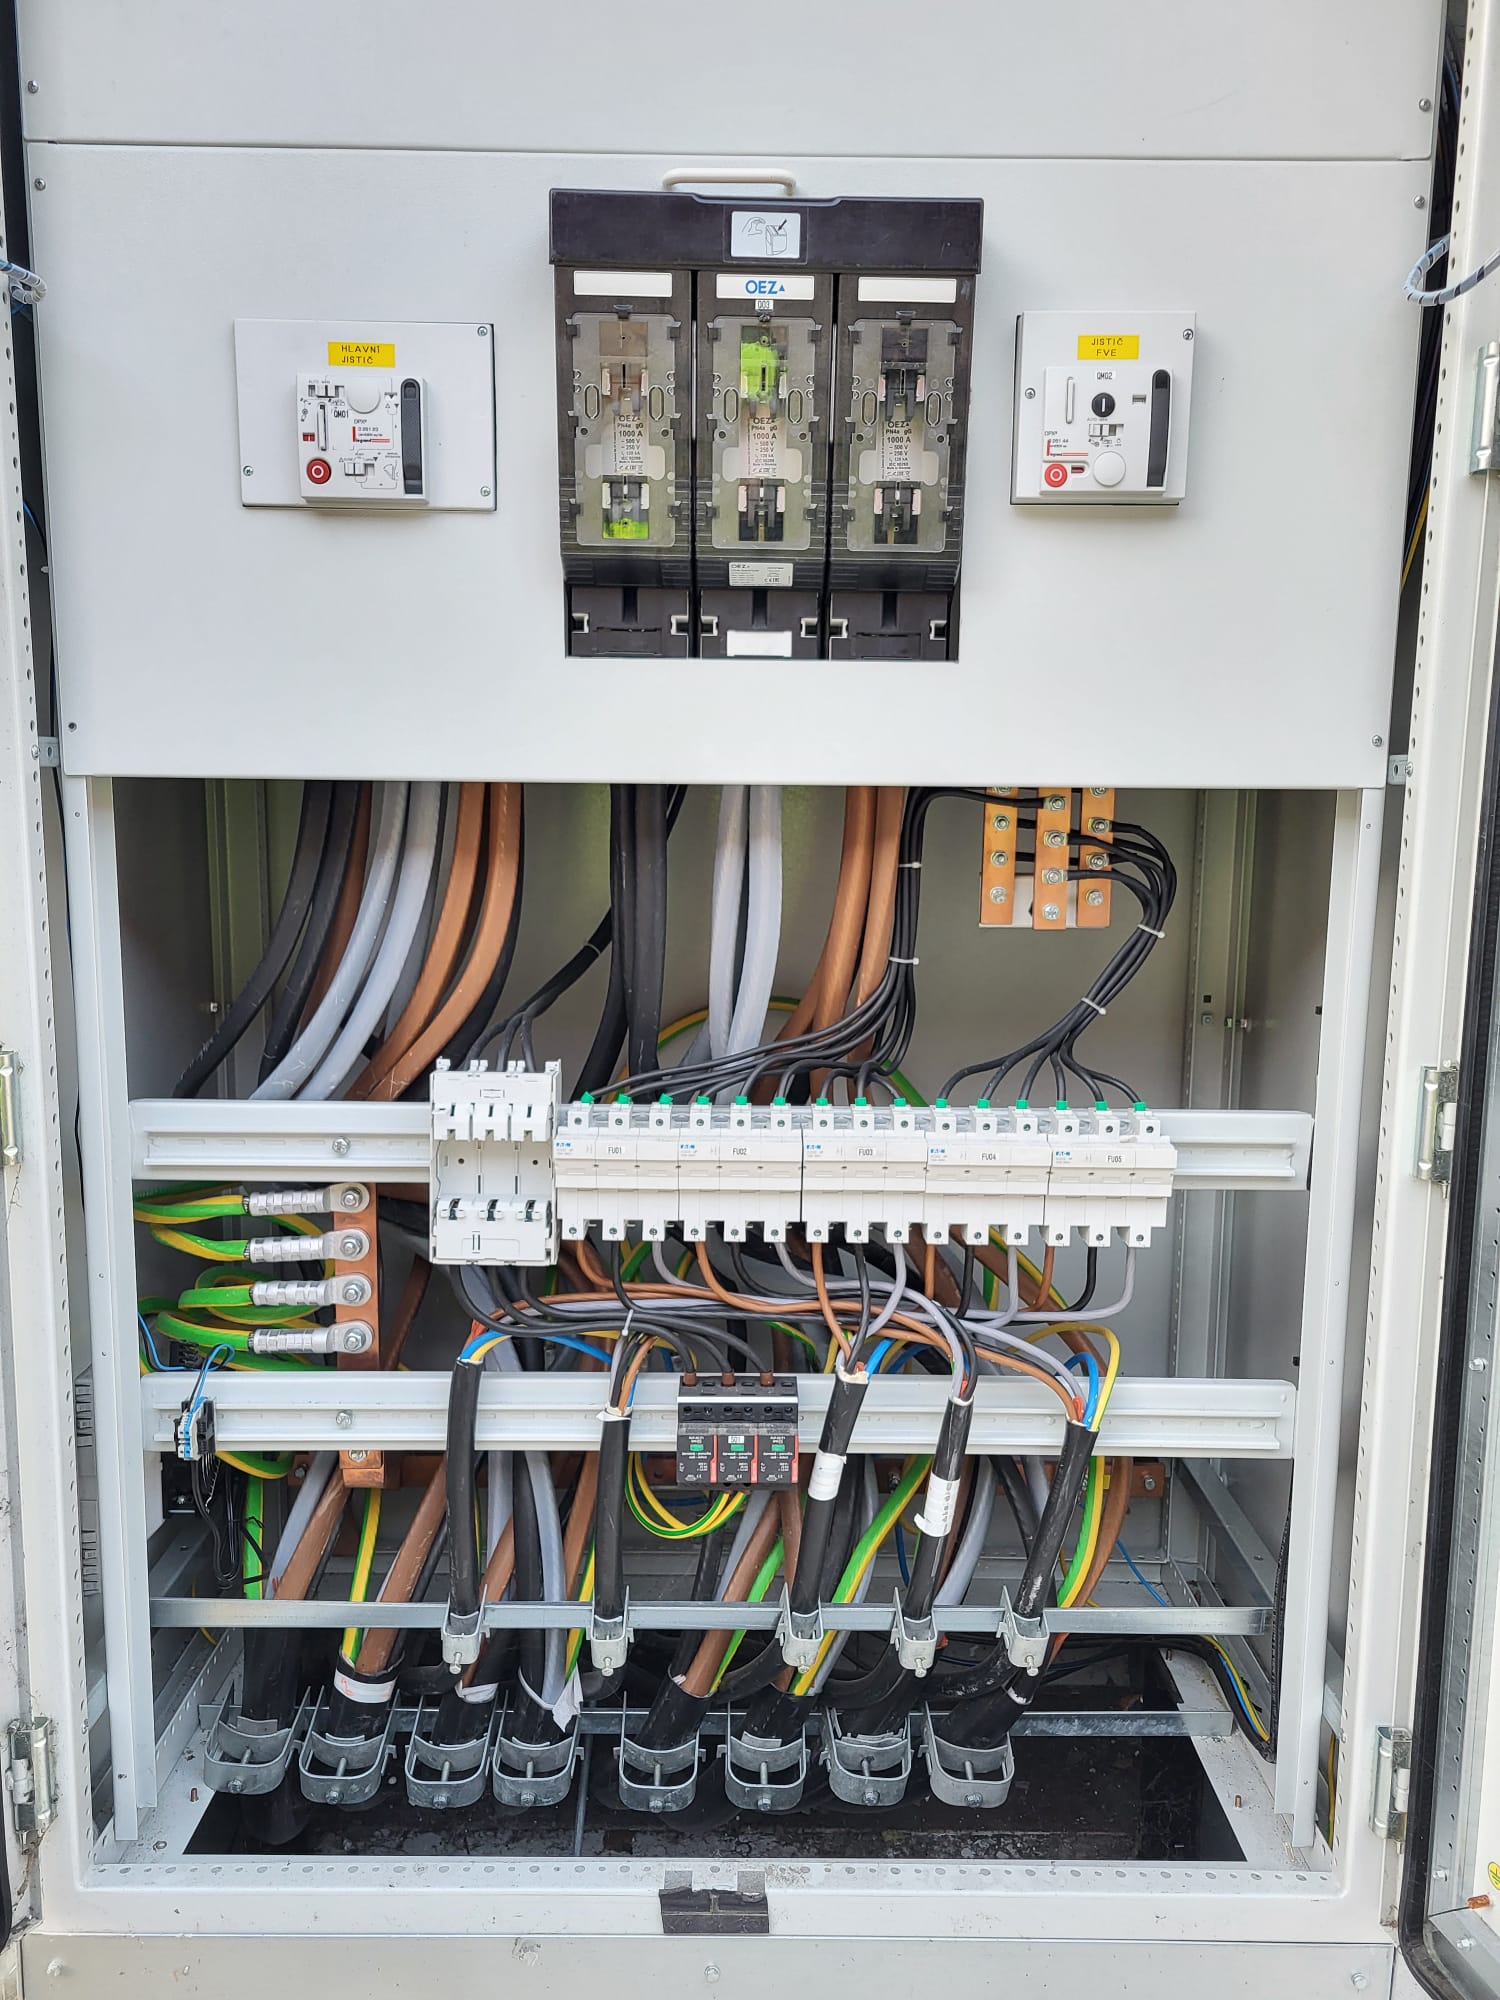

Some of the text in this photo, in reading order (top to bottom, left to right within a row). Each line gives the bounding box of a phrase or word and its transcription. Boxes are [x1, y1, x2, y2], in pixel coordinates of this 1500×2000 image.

[745, 279, 778, 294] OEZ
[1091, 337, 1124, 346] JISTIČ
[1096, 348, 1117, 357] FVE
[341, 355, 374, 364] JISTIČ
[1096, 371, 1113, 380] QM02
[333, 409, 349, 418] QM01
[608, 1146, 622, 1154] FU01
[1107, 1155, 1122, 1163] FU05
